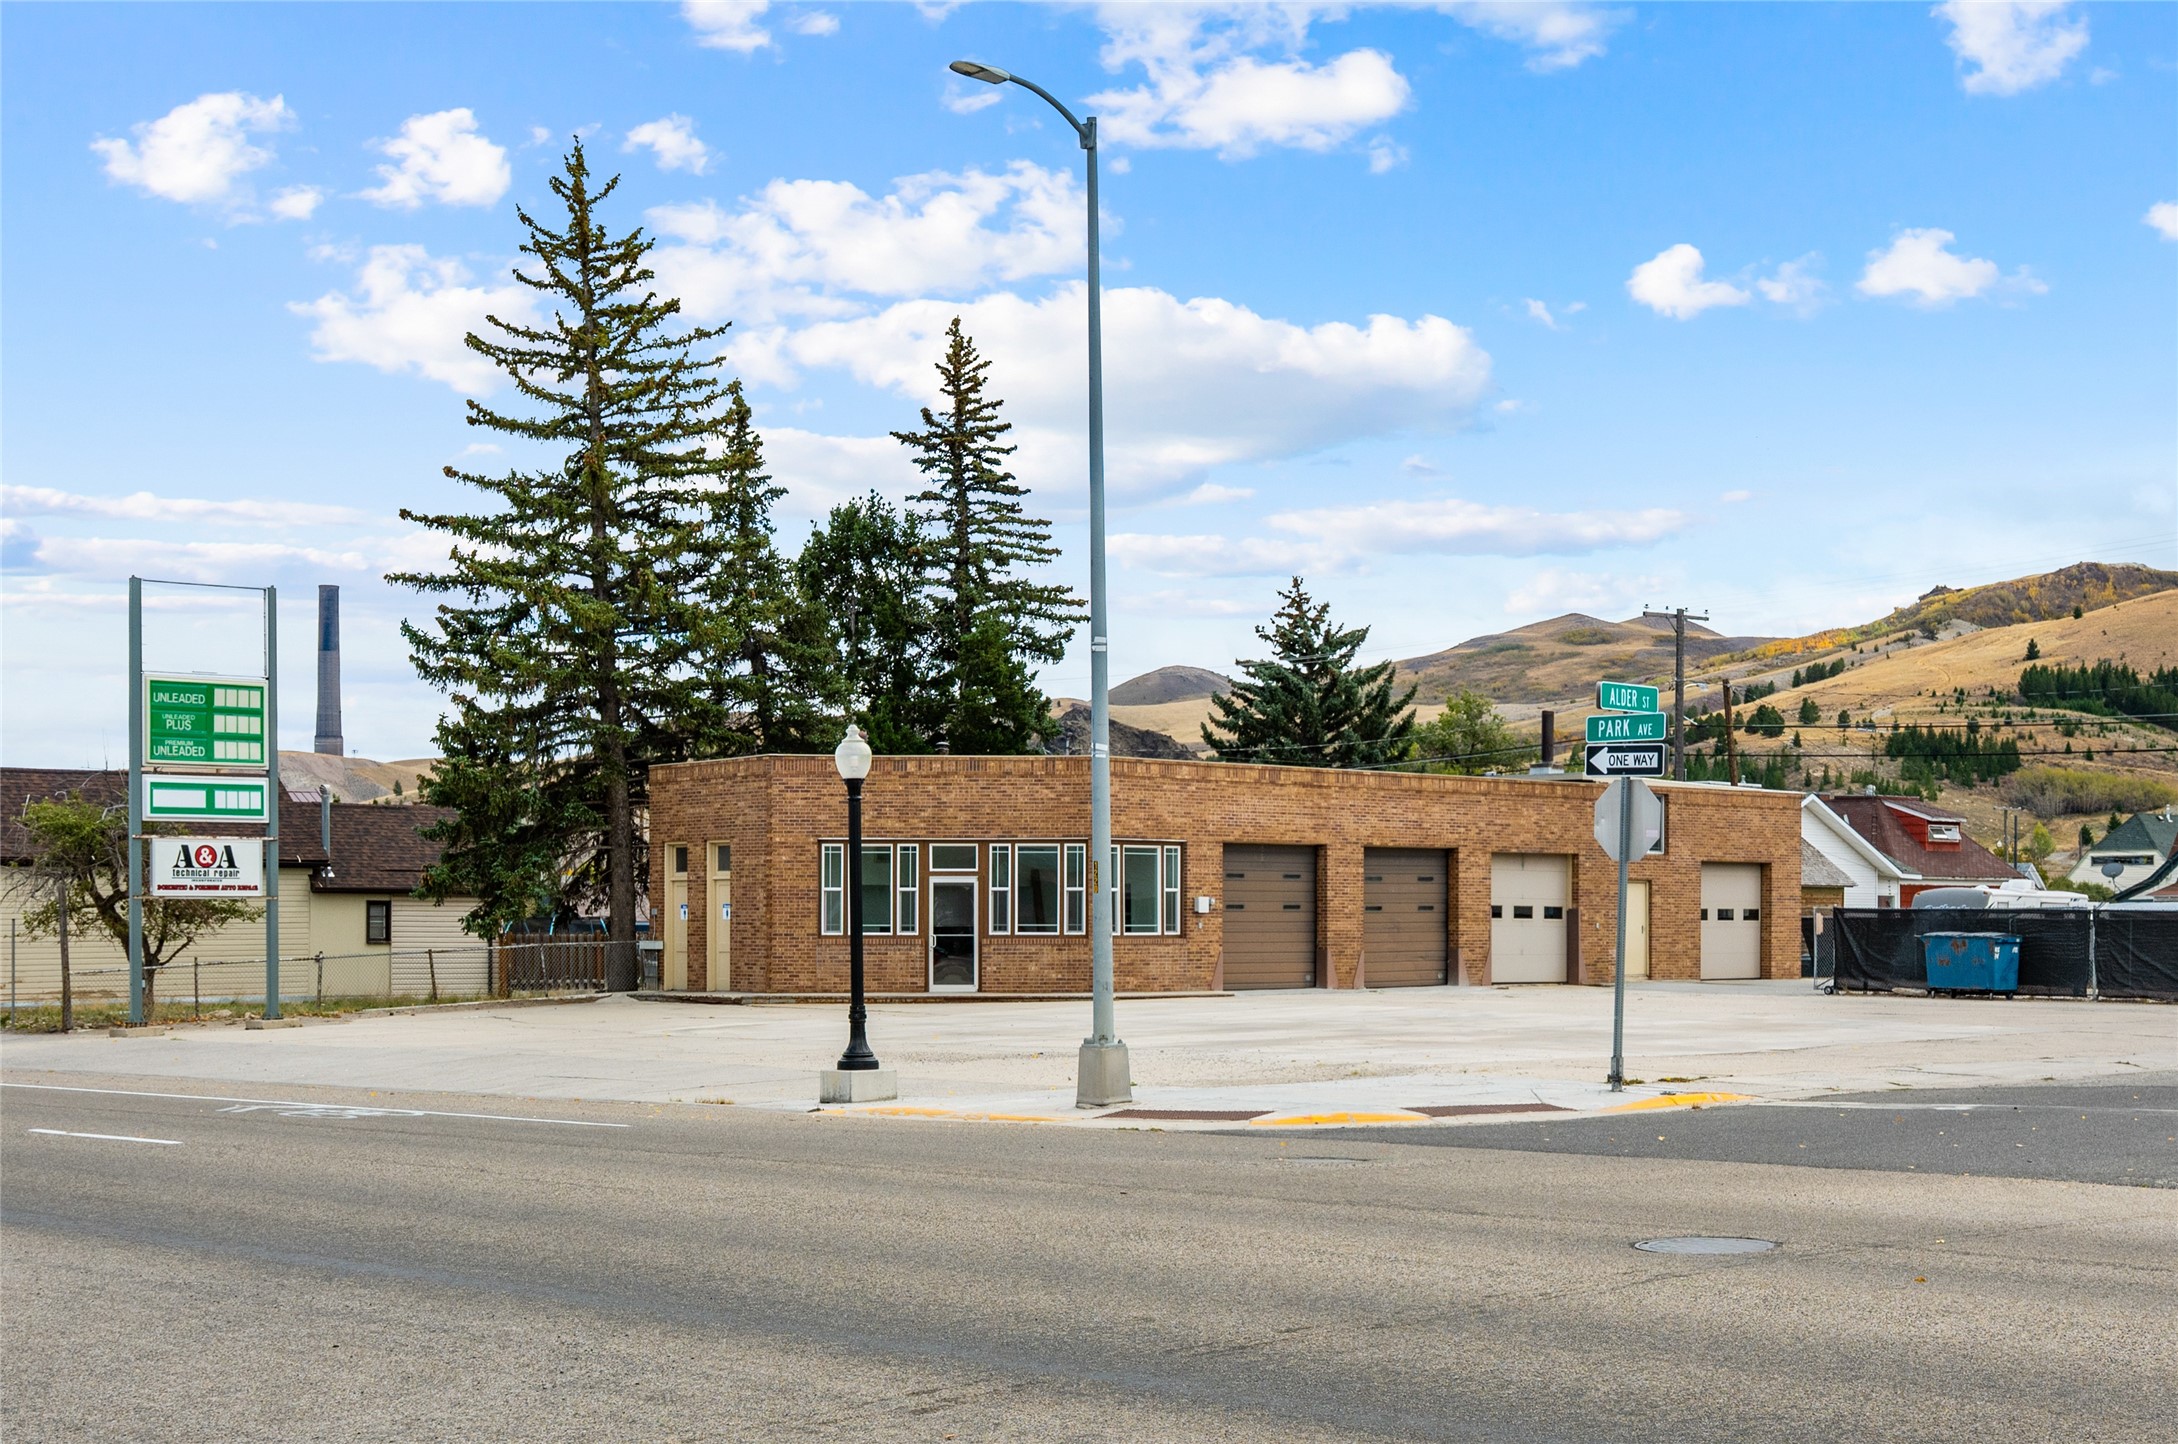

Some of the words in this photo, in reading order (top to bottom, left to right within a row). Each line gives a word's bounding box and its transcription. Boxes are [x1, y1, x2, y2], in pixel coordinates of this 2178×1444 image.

[153, 692, 206, 704] UNLEADED
[1609, 687, 1638, 708] ALDER
[1642, 696, 1650, 709] ST
[166, 720, 192, 731] PLUS
[1598, 719, 1630, 738] PARK
[1637, 723, 1653, 736] AVE
[153, 746, 206, 757] UNLEADED
[1608, 754, 1630, 767] ONE
[1633, 754, 1655, 766] WAY
[172, 869, 210, 877] technical
[214, 870, 240, 878] repair
